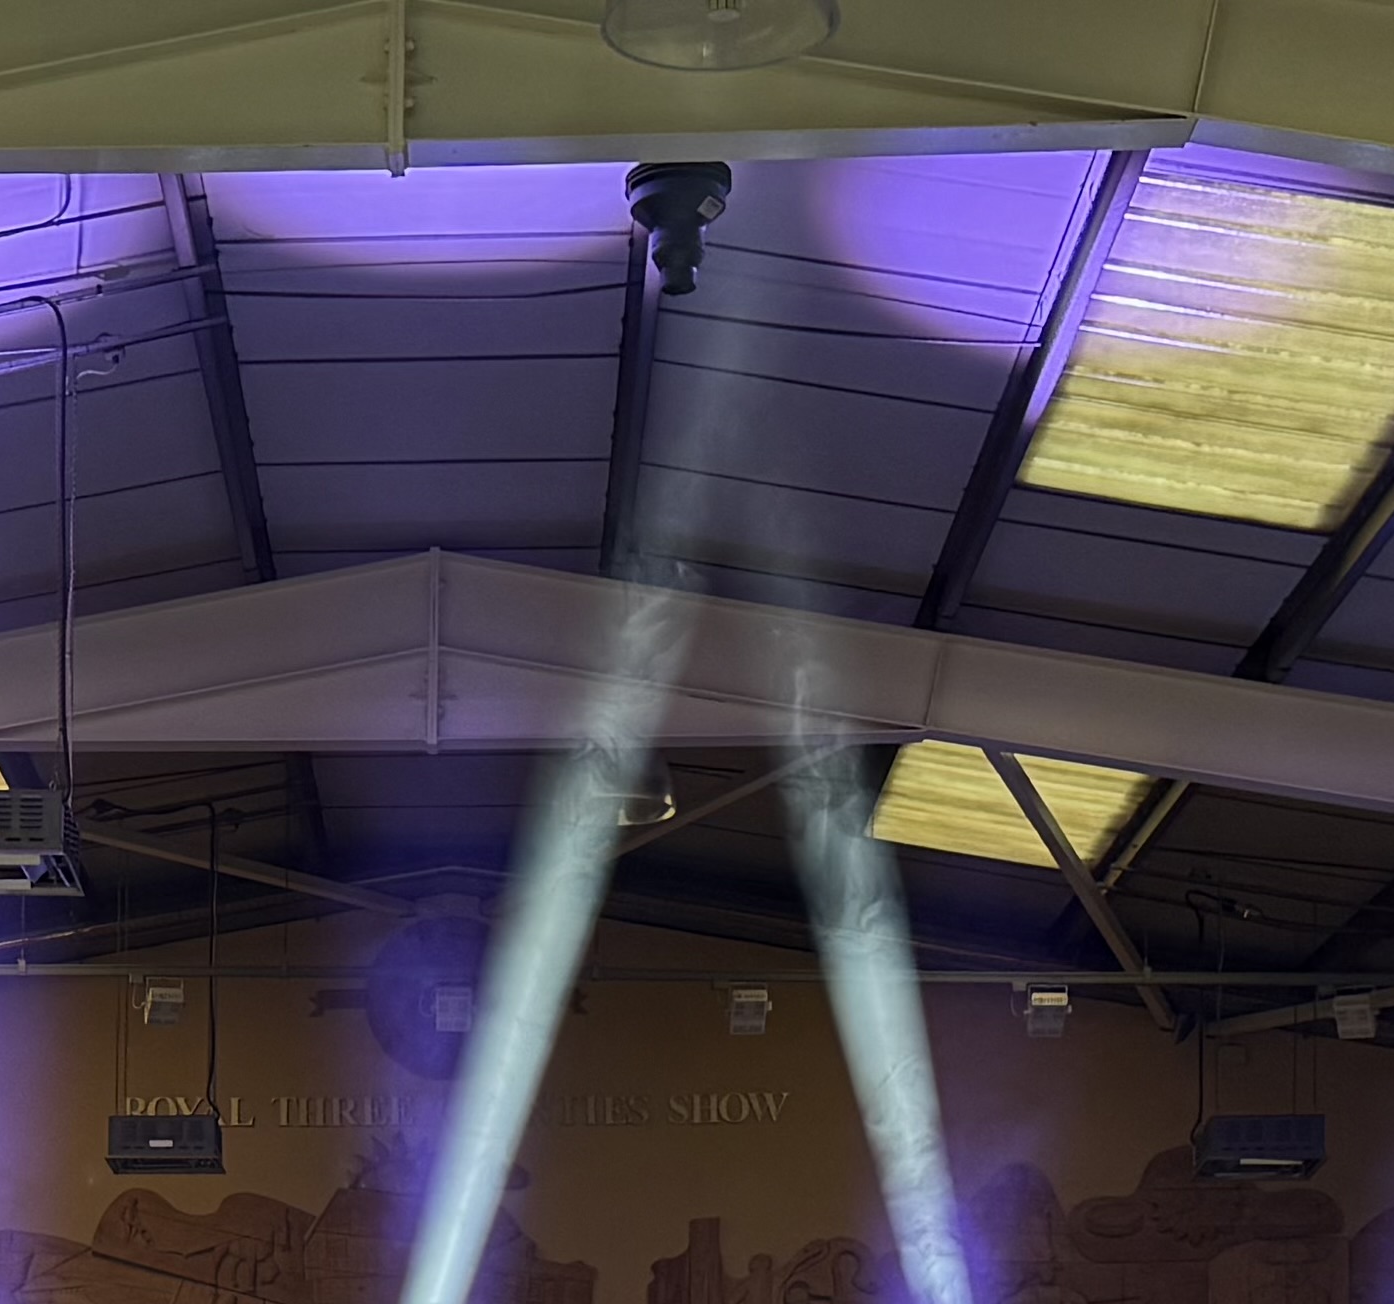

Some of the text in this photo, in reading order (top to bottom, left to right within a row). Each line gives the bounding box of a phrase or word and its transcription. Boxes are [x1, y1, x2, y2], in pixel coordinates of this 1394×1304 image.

[126, 1096, 254, 1127] ROYL
[271, 1096, 413, 1126] THREE
[668, 1092, 789, 1124] SHOW
